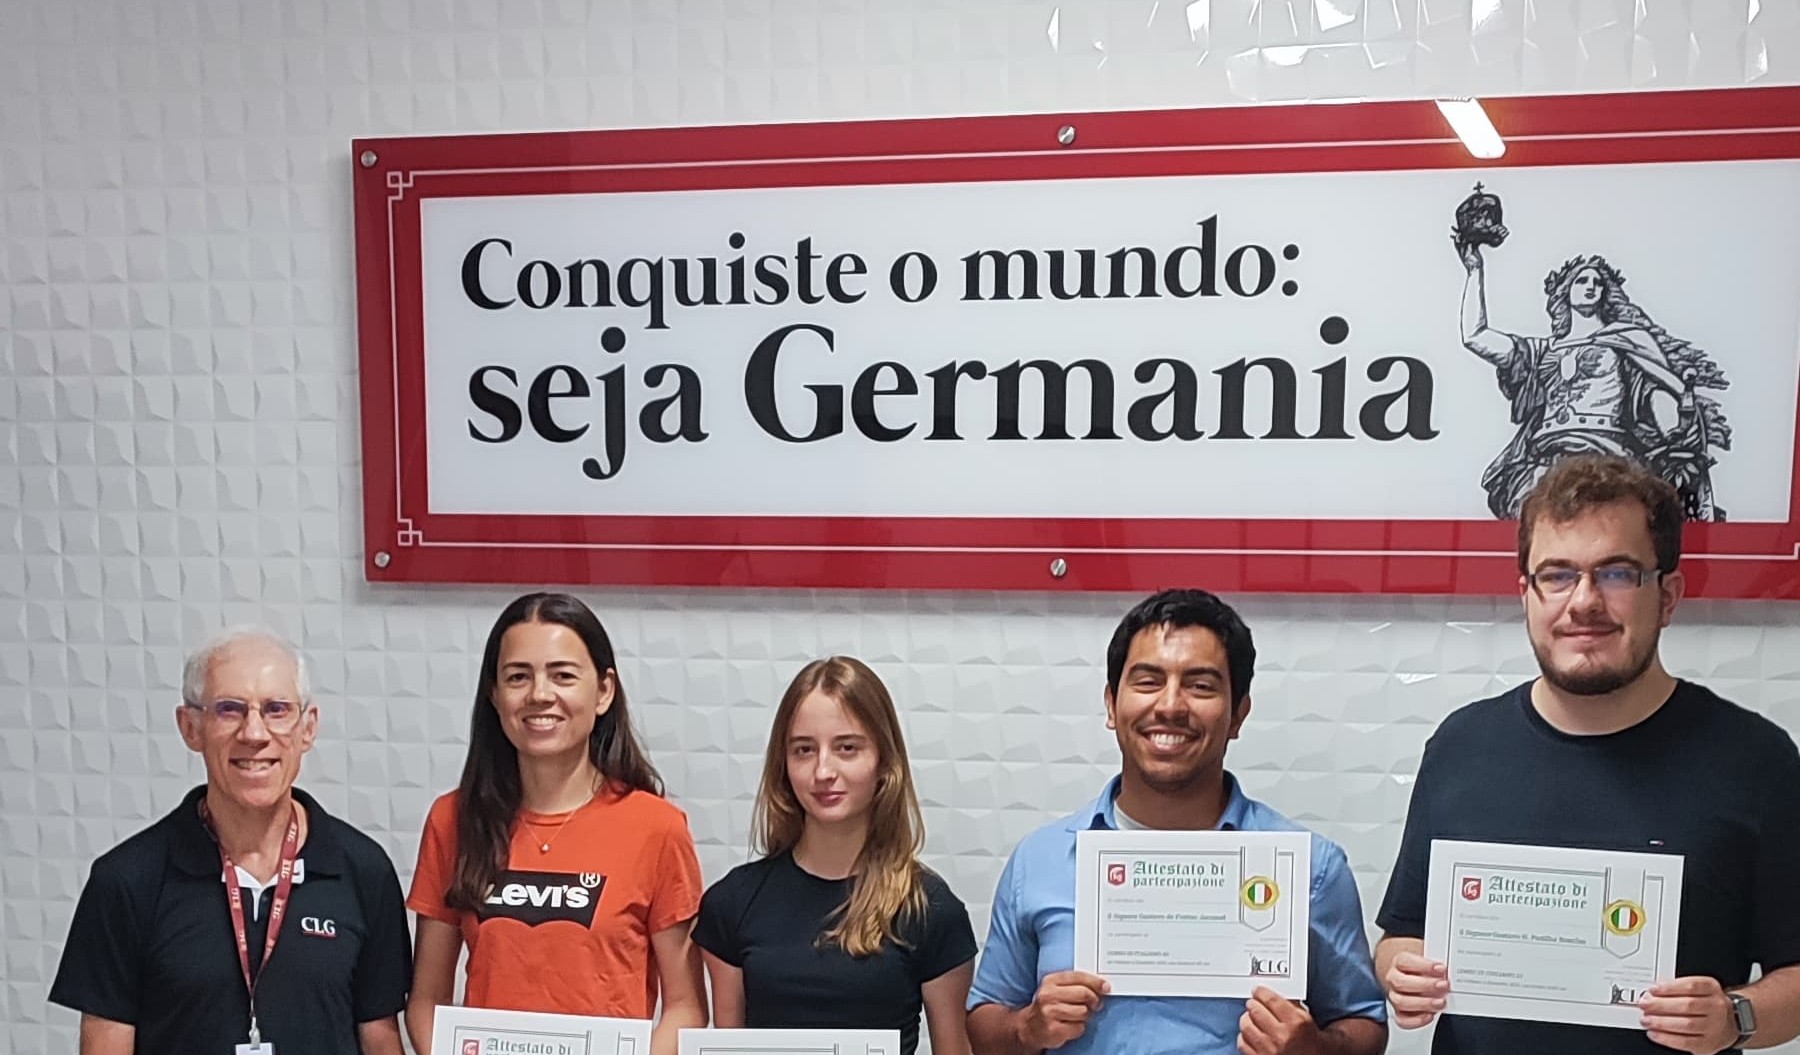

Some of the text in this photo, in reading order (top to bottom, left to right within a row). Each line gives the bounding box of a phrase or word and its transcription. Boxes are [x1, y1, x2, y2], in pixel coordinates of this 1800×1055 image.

[461, 213, 1300, 330] Conquiste o mundo:
[467, 314, 1442, 480] seja Germania
[1132, 861, 1225, 875] Attestato di
[1133, 875, 1225, 889] partecipazione
[1488, 875, 1588, 897] Attestato di
[1488, 892, 1588, 909] partecipazione
[301, 917, 336, 934] CLG
[1257, 959, 1288, 973] CLG
[485, 1037, 571, 1055] Attestato di
